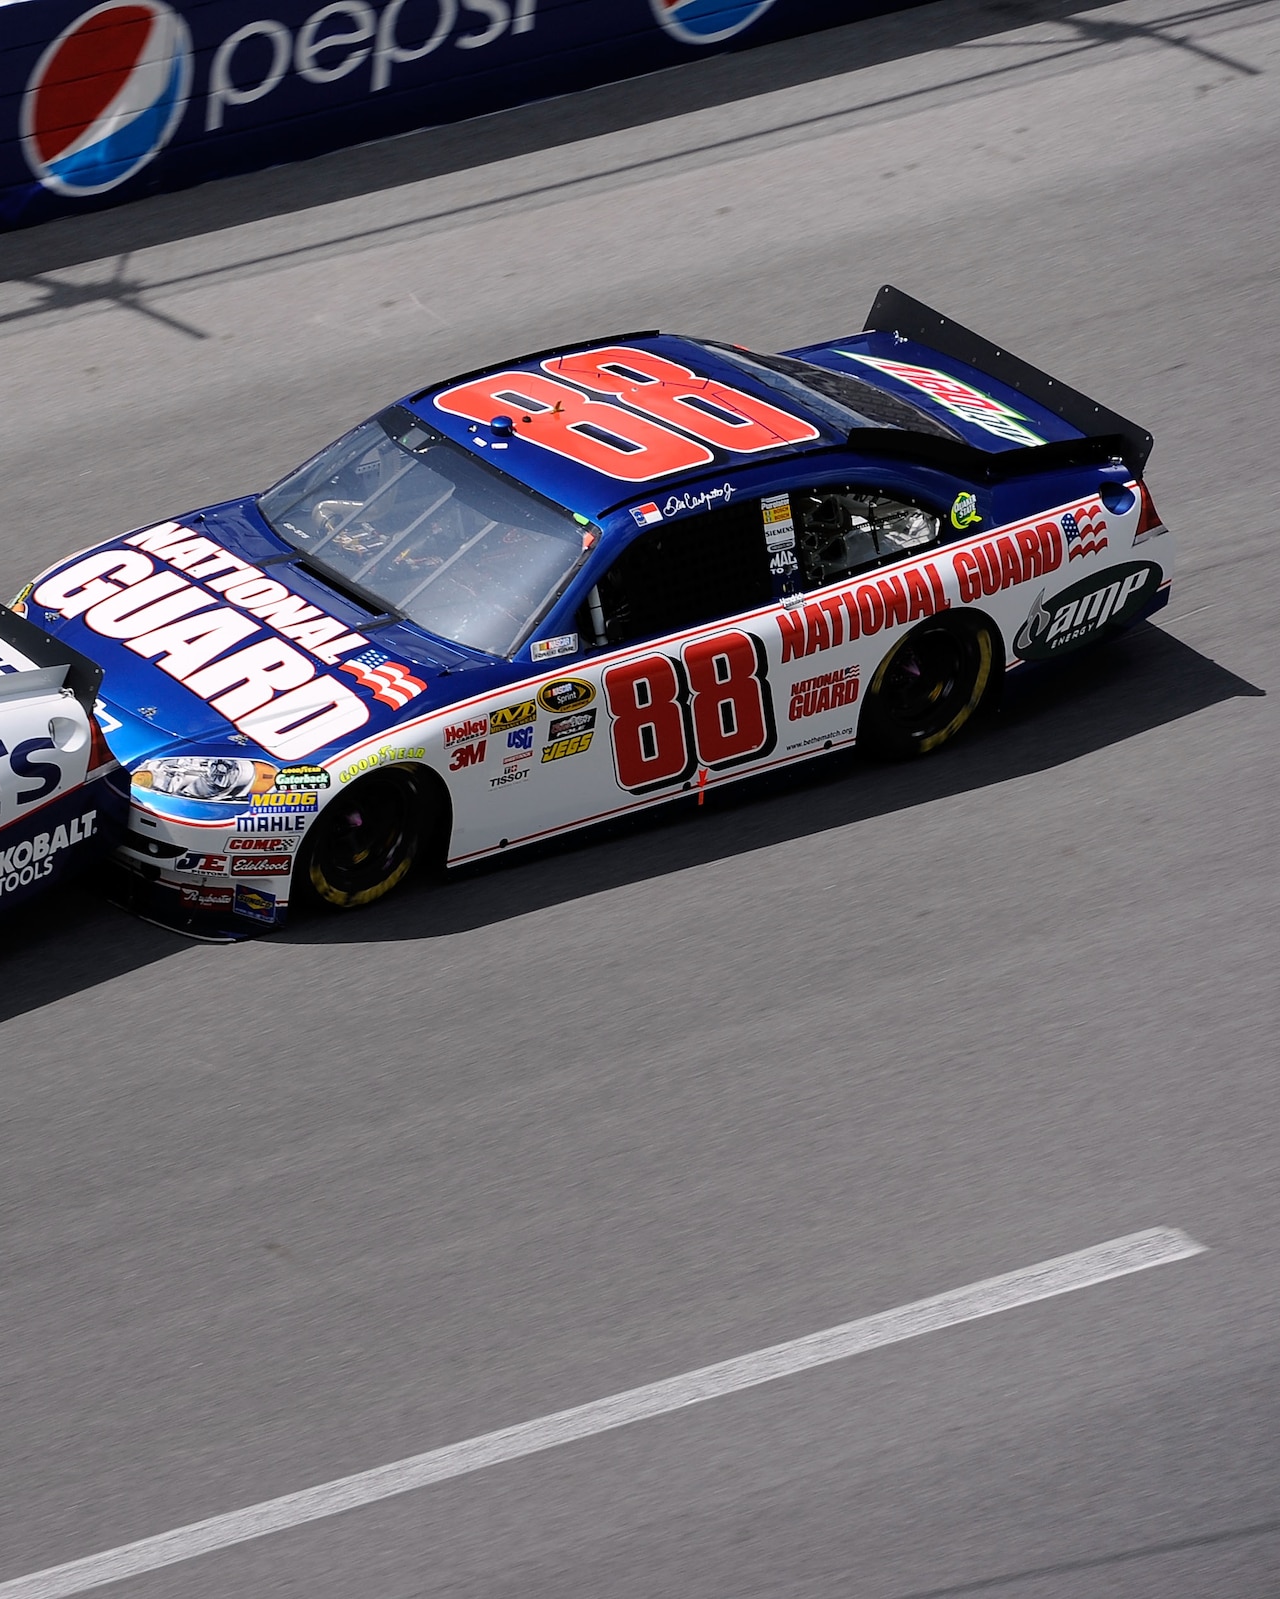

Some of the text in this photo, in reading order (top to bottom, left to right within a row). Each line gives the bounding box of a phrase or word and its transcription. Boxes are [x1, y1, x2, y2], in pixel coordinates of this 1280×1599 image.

[433, 344, 822, 483] 88
[766, 526, 794, 537] SIEMENS
[770, 551, 797, 569] MAC
[123, 521, 370, 665] NATIONAL
[776, 521, 1063, 664] NATIONAL GUARD
[1051, 622, 1095, 649] ENERGY
[33, 550, 370, 761] GUARD
[791, 669, 844, 696] NATIONAL
[557, 691, 577, 704] Sprint
[788, 678, 860, 721] GUARD
[603, 629, 770, 793] 88
[445, 719, 487, 742] Holley
[507, 726, 533, 749] USG
[786, 727, 853, 751] www.bethematch.org
[449, 740, 487, 771] 3M
[542, 731, 594, 763] JEGS
[338, 745, 426, 784] GOODYEAR
[275, 773, 329, 785] Gatorback
[279, 783, 327, 791] BELTS
[490, 769, 530, 787] TISSOT
[250, 792, 317, 807] MOOG
[236, 815, 305, 832] MAHLE
[229, 839, 282, 850] COMP
[176, 852, 228, 871] JE
[233, 859, 289, 871] Edelbrock
